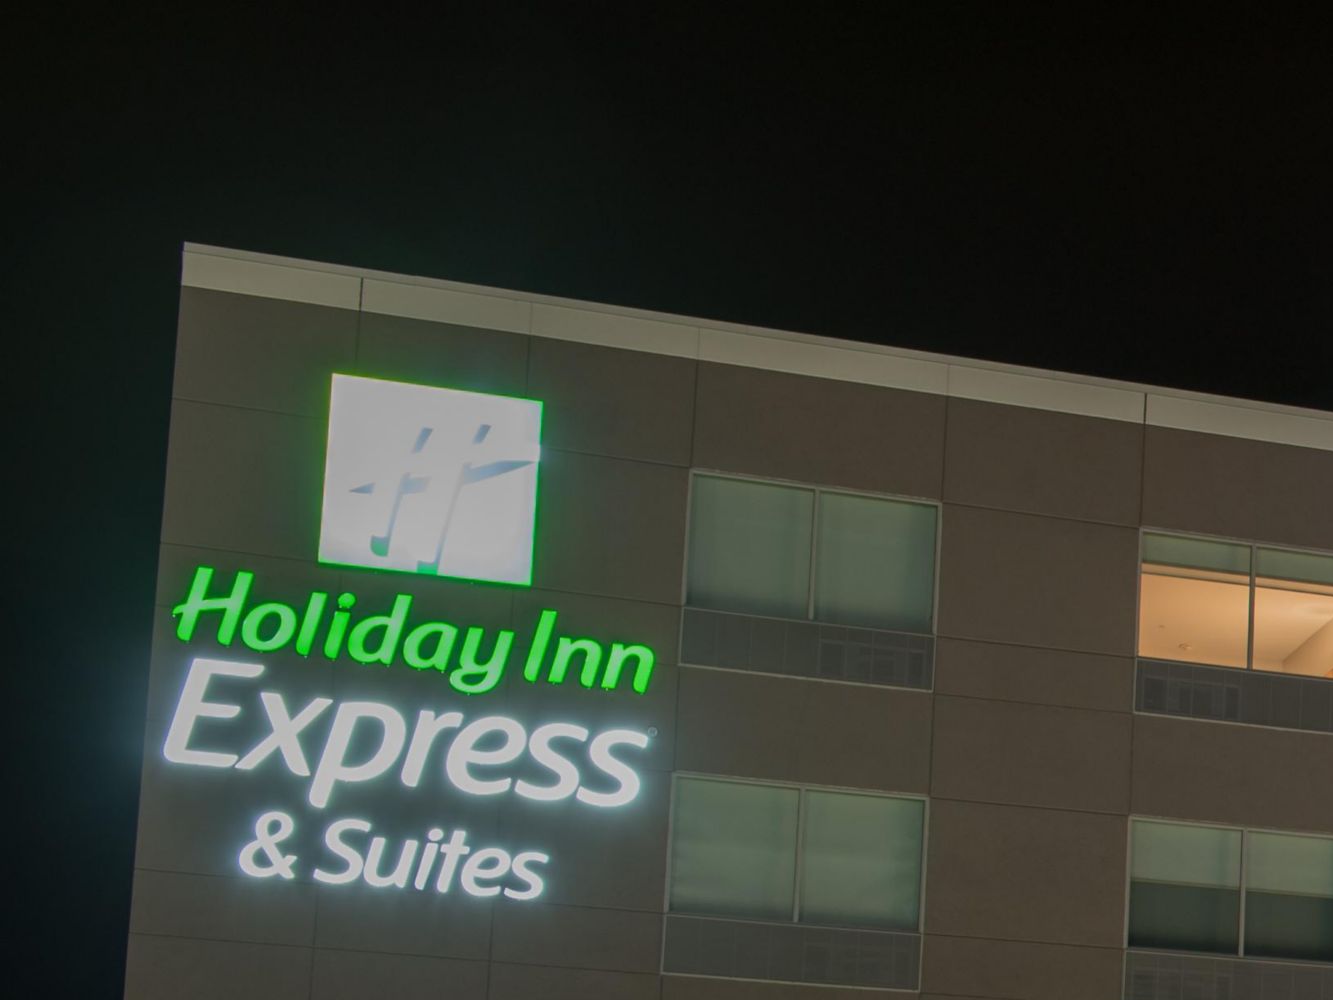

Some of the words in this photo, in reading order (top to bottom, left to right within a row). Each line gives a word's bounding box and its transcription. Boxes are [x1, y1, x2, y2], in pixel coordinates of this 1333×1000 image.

[171, 566, 515, 694] Holiday
[523, 609, 655, 693] Inn
[163, 657, 649, 808] Express
[238, 811, 298, 880] &
[313, 817, 549, 900] Suites
